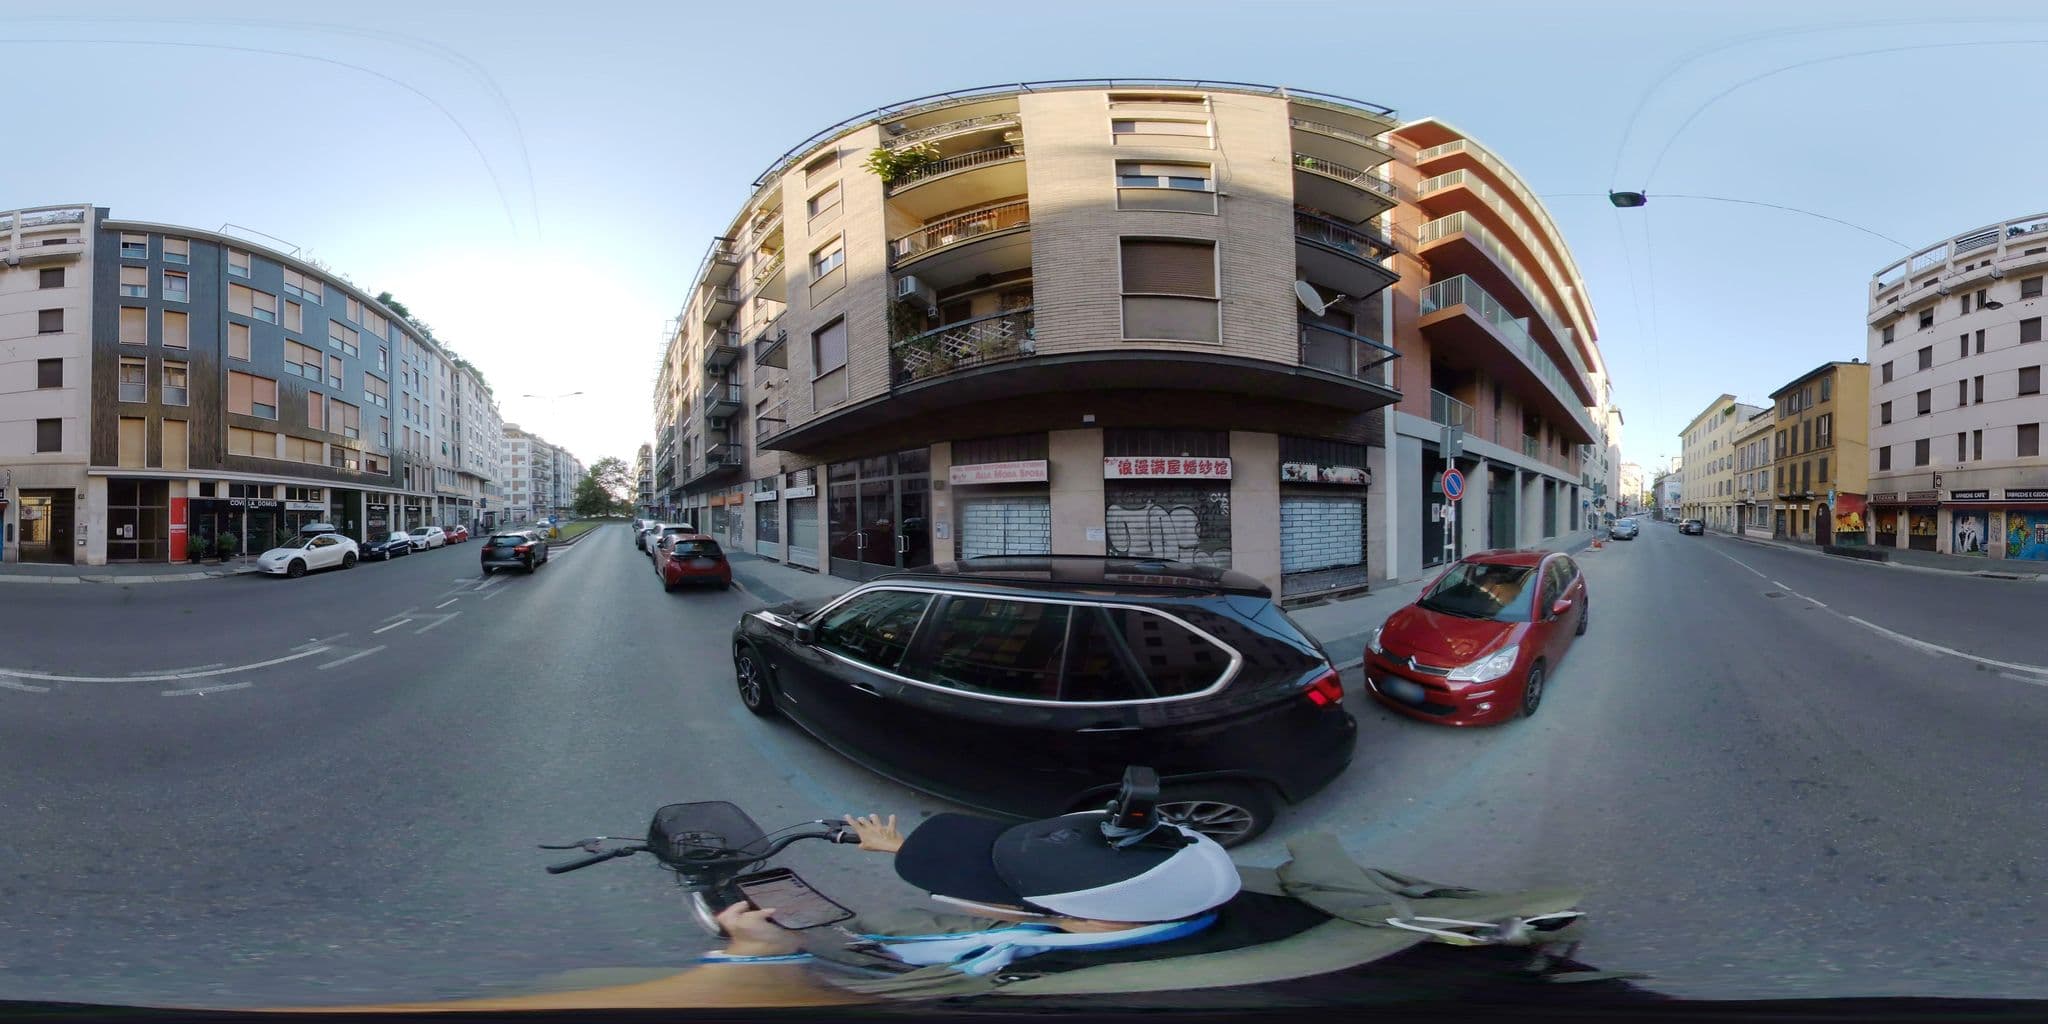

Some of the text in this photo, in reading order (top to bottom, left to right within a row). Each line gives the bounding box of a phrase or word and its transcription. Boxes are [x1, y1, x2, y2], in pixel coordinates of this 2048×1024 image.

[1118, 459, 1228, 475] 浪漫满屋婚纱馆
